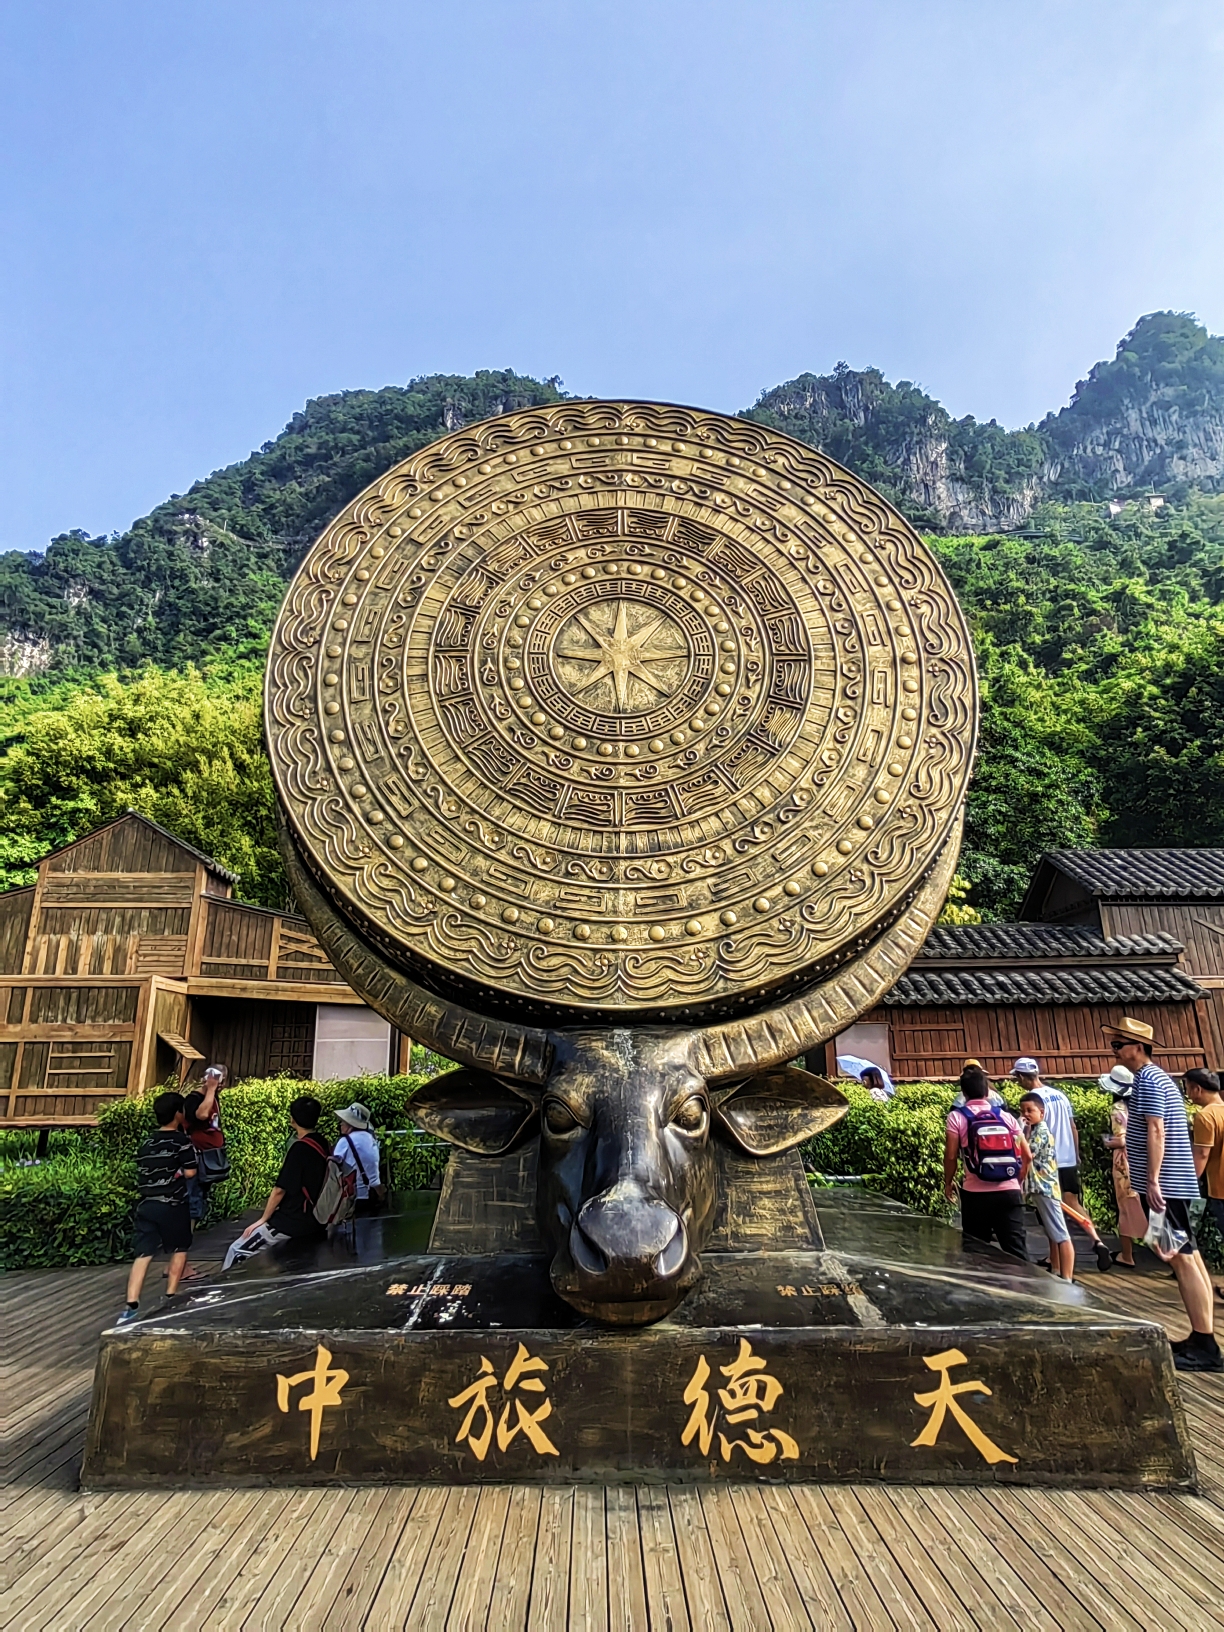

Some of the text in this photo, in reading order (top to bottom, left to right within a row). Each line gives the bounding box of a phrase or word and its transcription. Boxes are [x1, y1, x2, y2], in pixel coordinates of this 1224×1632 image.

[385, 1283, 473, 1296] 禁止踩踏
[277, 1338, 1018, 1464] 中旅德天
